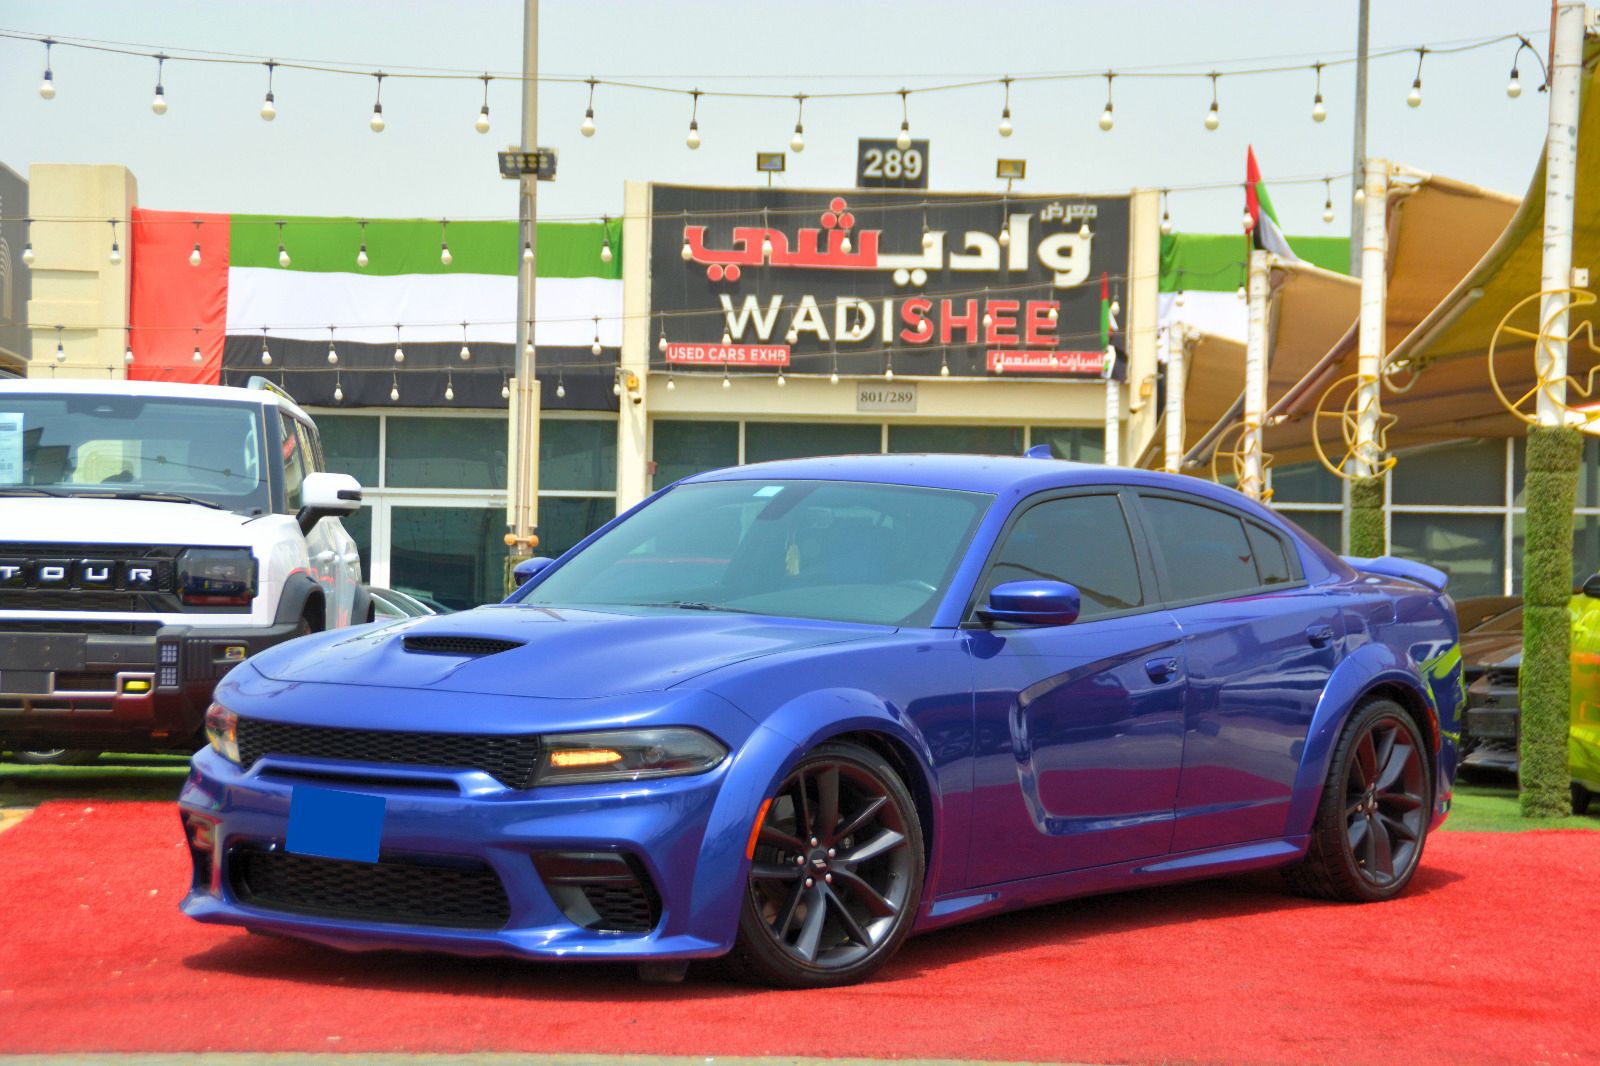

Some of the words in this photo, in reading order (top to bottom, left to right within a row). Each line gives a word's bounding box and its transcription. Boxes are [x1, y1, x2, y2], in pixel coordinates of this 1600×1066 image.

[863, 148, 923, 180] 289
[1040, 201, 1098, 225] معرض
[719, 293, 1061, 346] WADISHEE
[668, 347, 704, 360] USED
[708, 348, 746, 361] CARS
[750, 348, 788, 362] EXHB
[860, 391, 914, 403] 801/289
